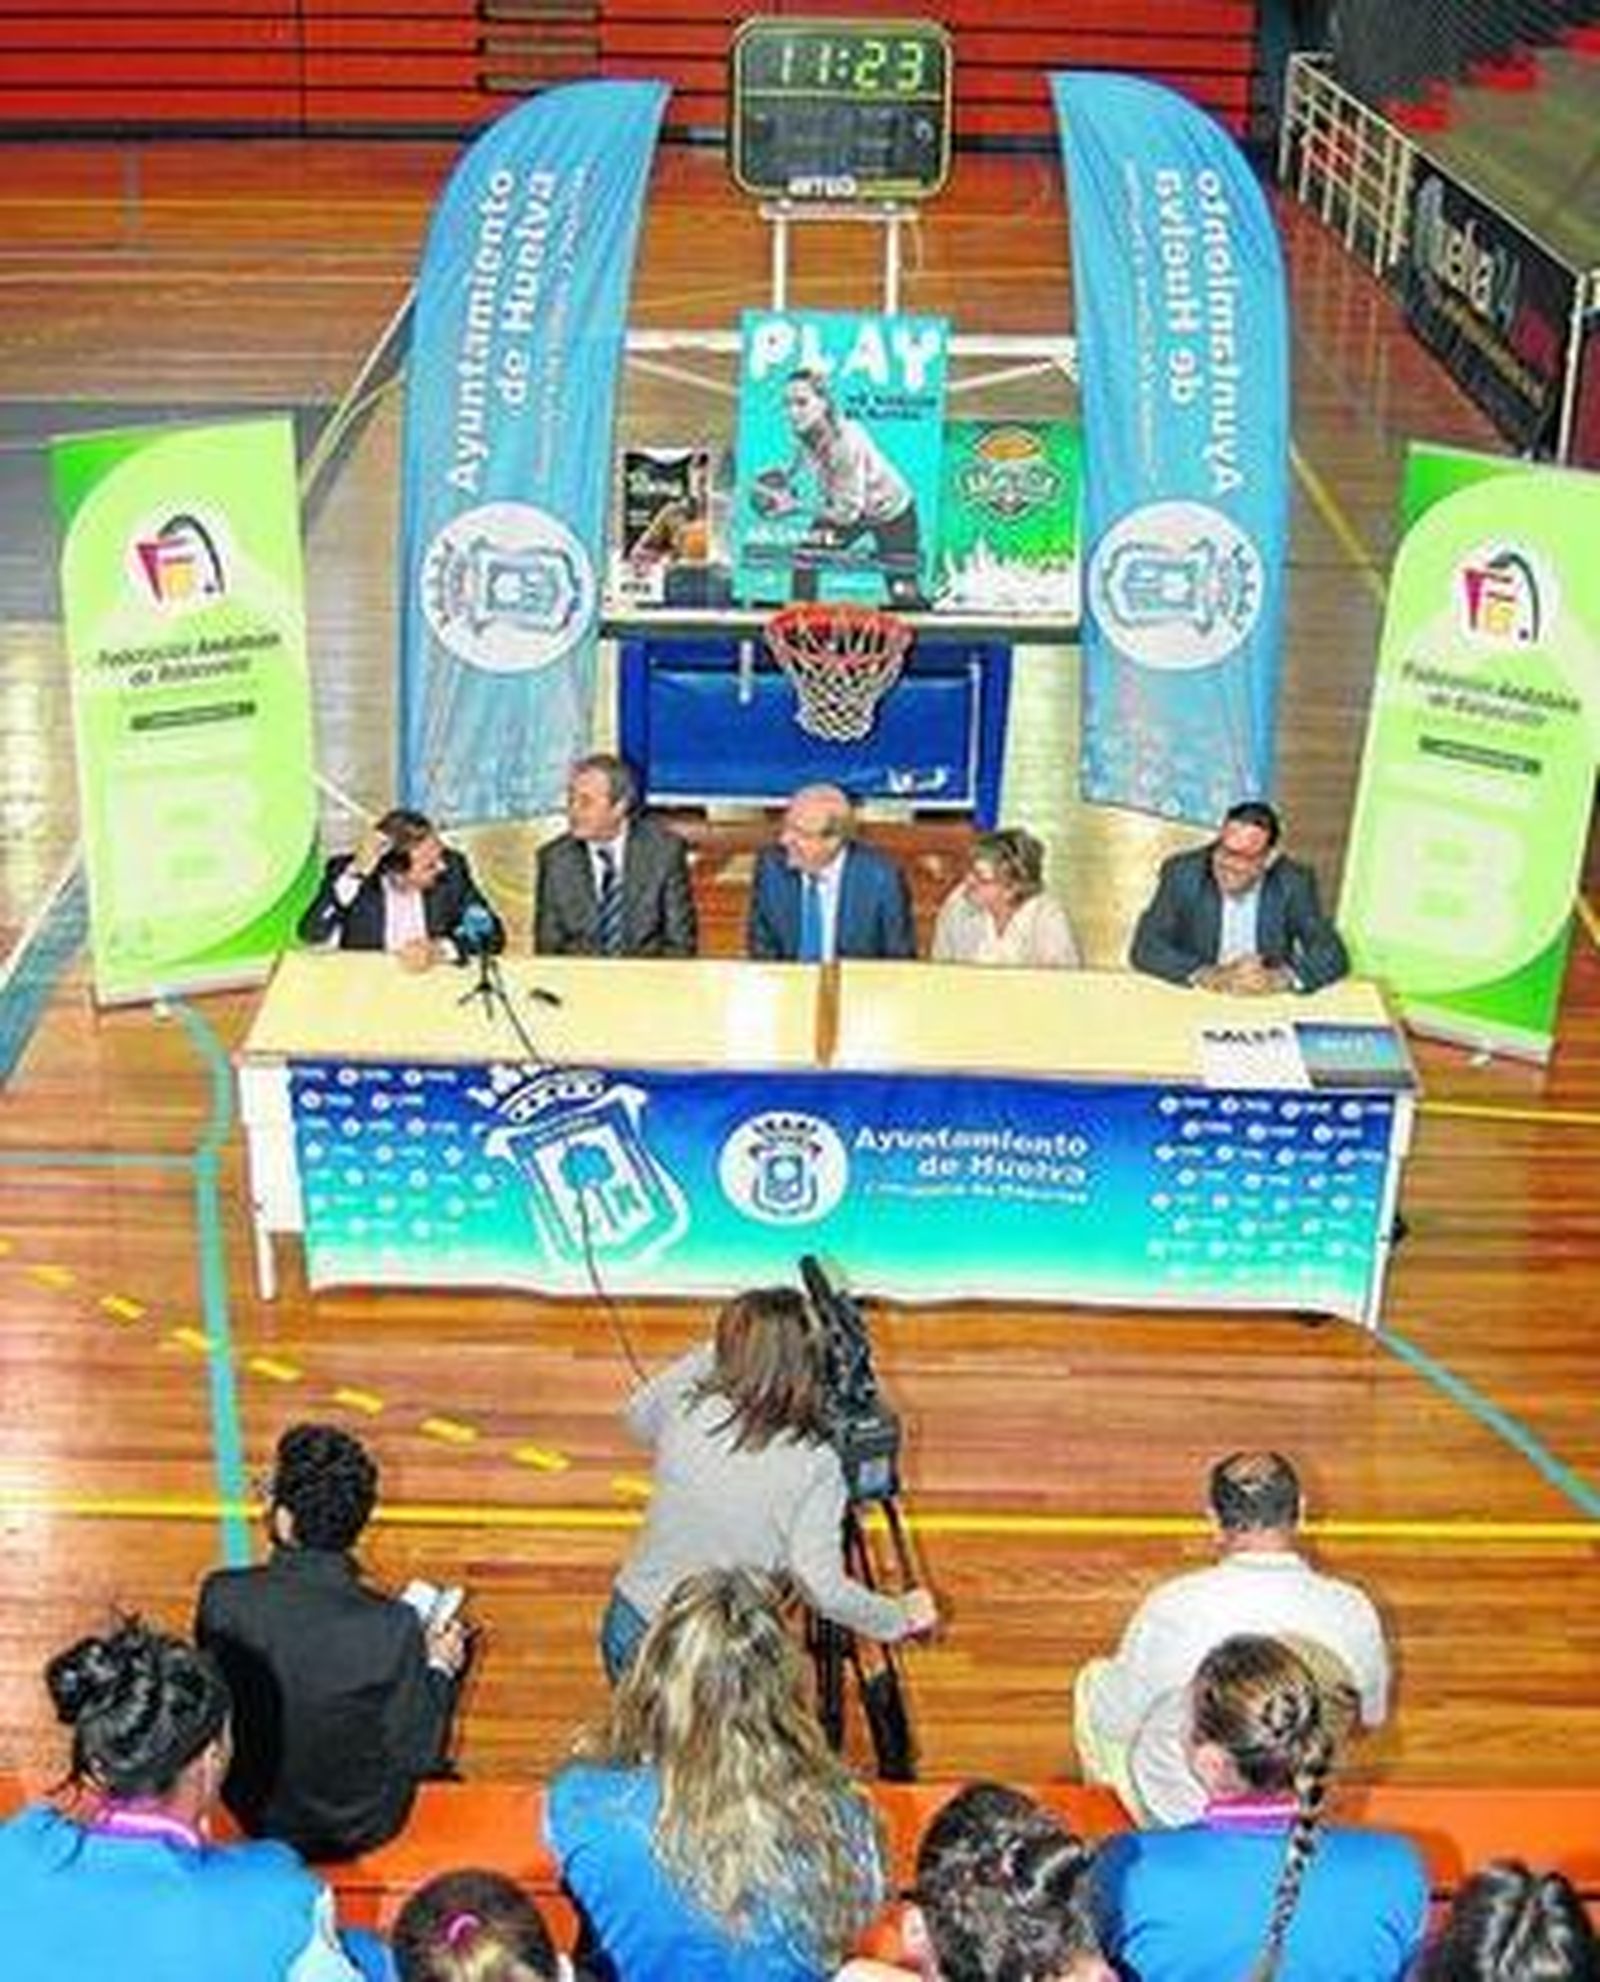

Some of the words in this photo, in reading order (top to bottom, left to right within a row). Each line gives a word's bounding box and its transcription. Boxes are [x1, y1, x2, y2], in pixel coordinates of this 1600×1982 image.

[780, 40, 924, 90] 11:23
[502, 170, 558, 331] Huelva
[447, 168, 518, 494] Ayuntamiento
[748, 318, 944, 393] PLAY
[500, 351, 530, 412] de
[853, 1124, 1089, 1160] Ayuntamiento
[917, 1154, 959, 1177] de
[968, 1154, 1088, 1186] Huelva
